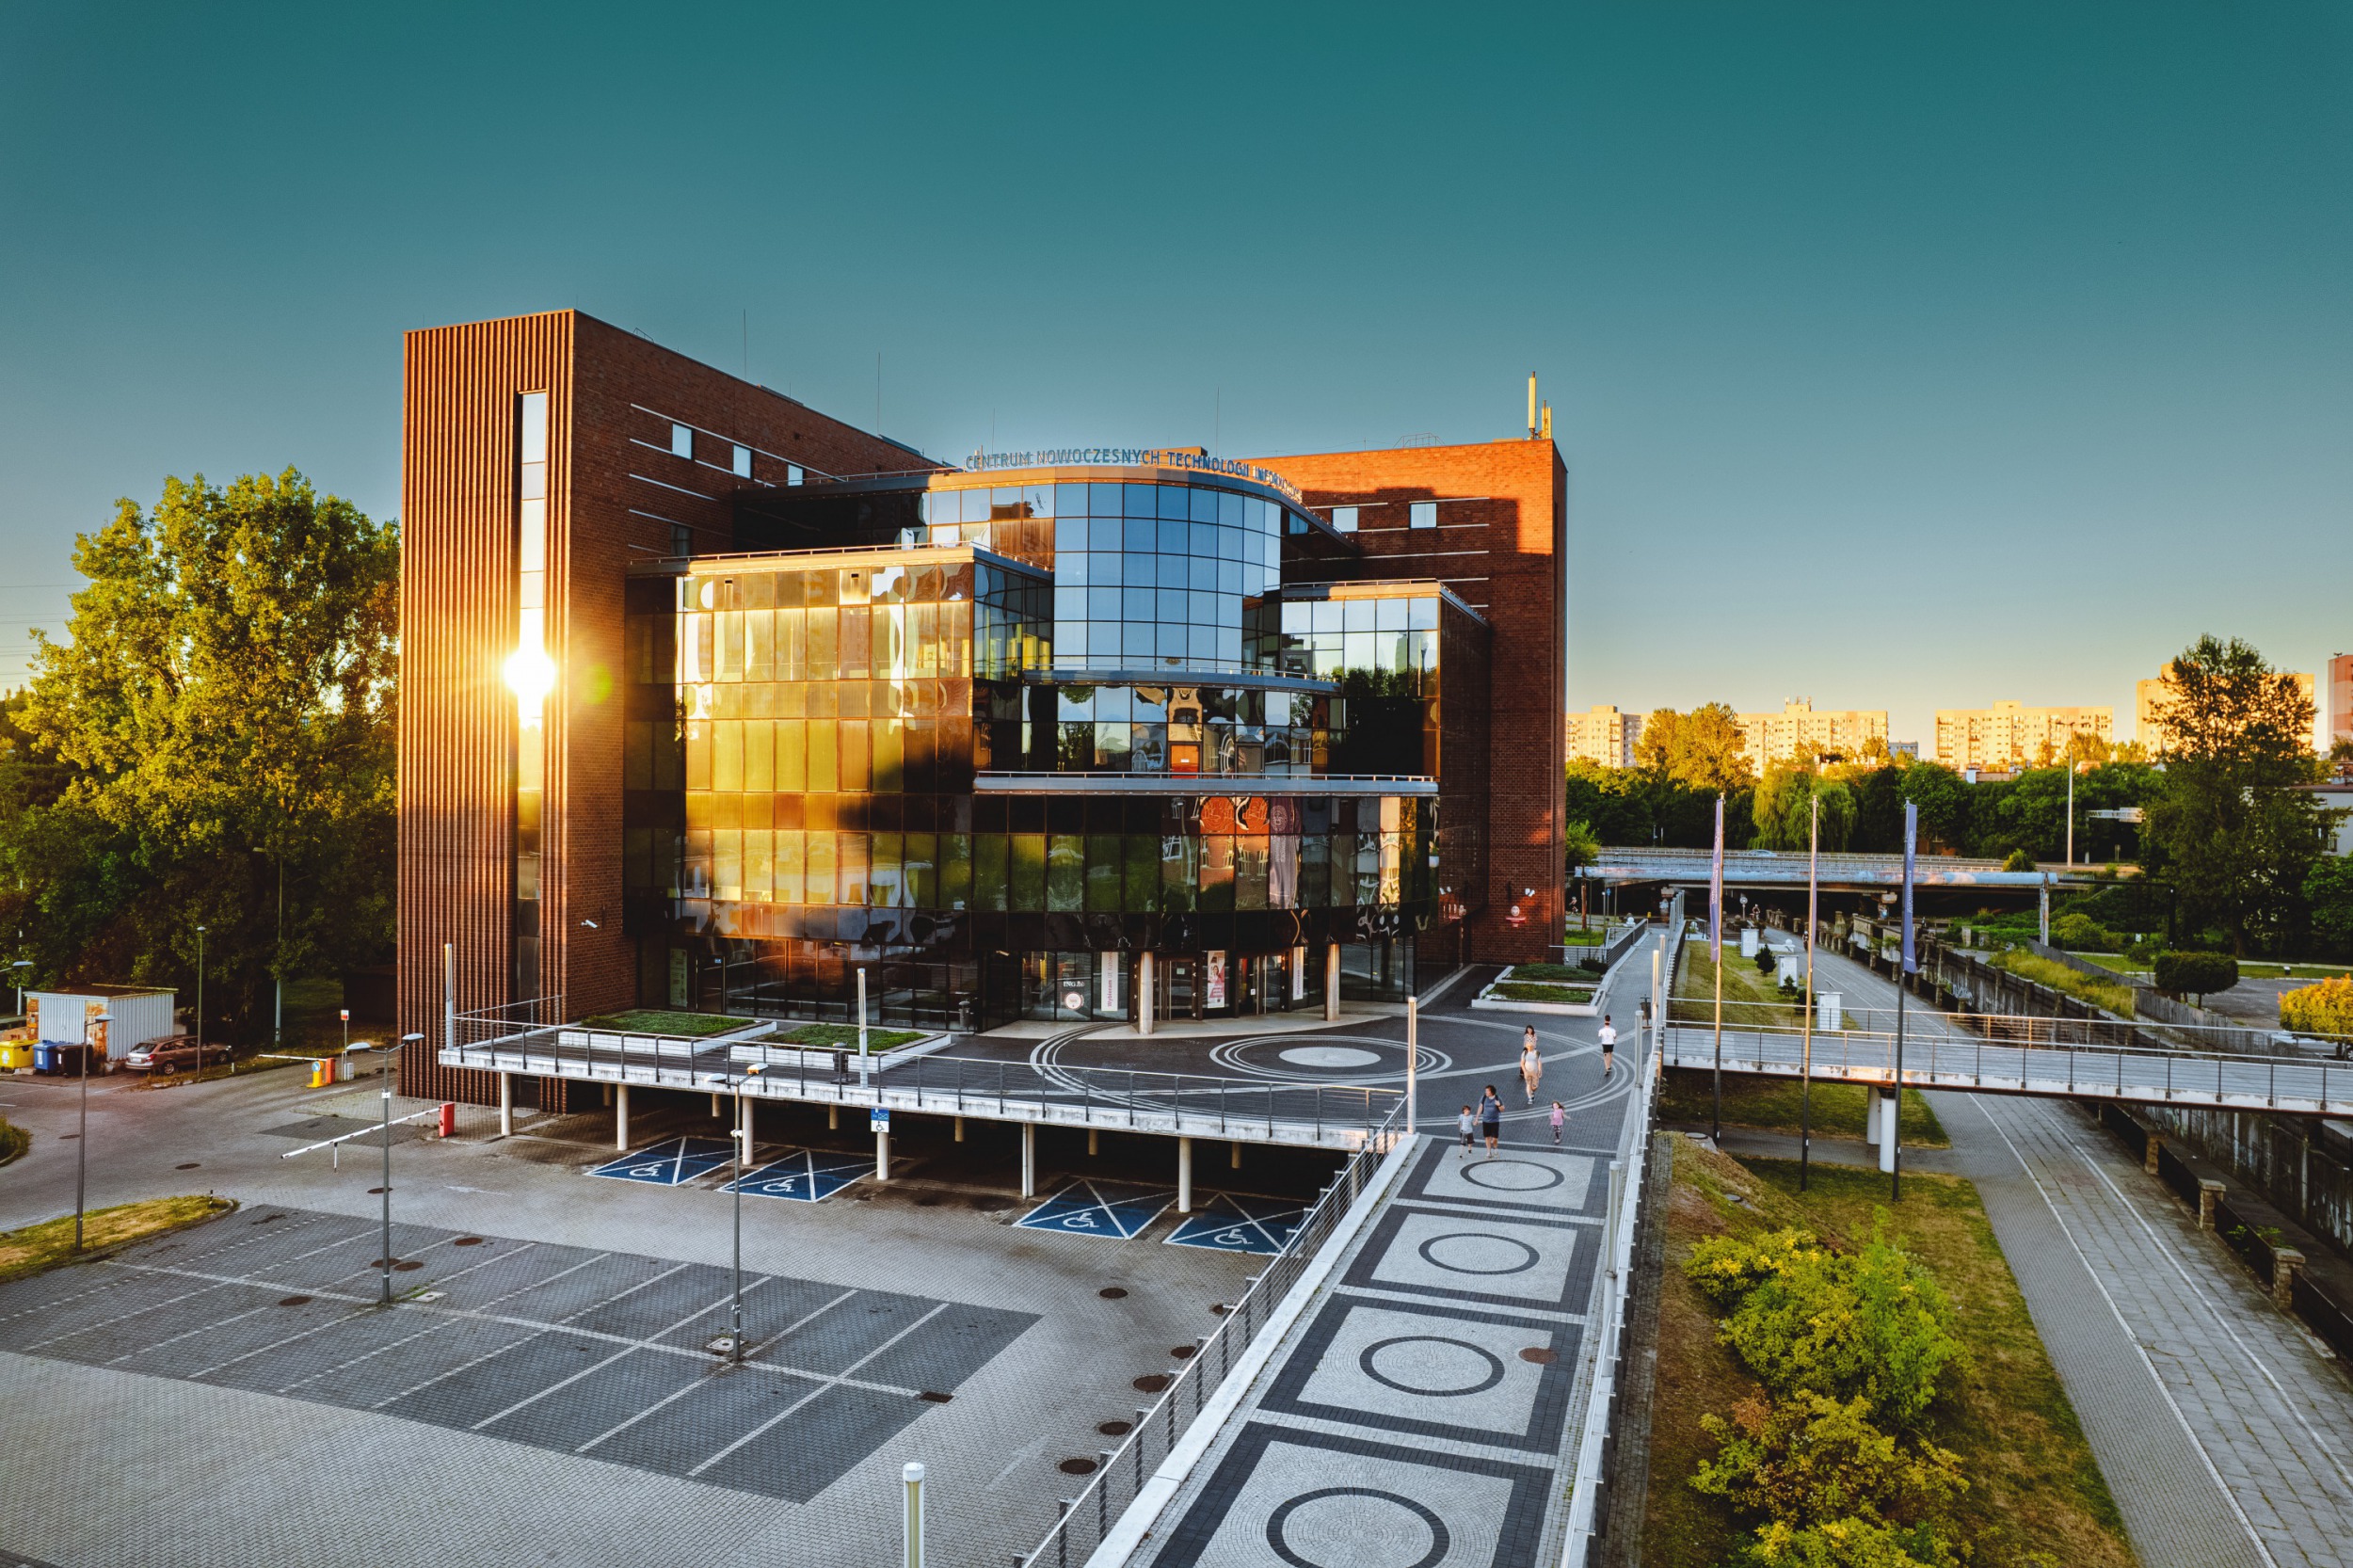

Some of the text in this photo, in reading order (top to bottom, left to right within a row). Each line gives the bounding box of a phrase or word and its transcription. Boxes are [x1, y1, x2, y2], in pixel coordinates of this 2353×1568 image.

[966, 451, 1032, 471] CENTRUM
[1036, 448, 1160, 466] NOWOCZESNYCH
[1167, 451, 1250, 476] TECHNOLOGII
